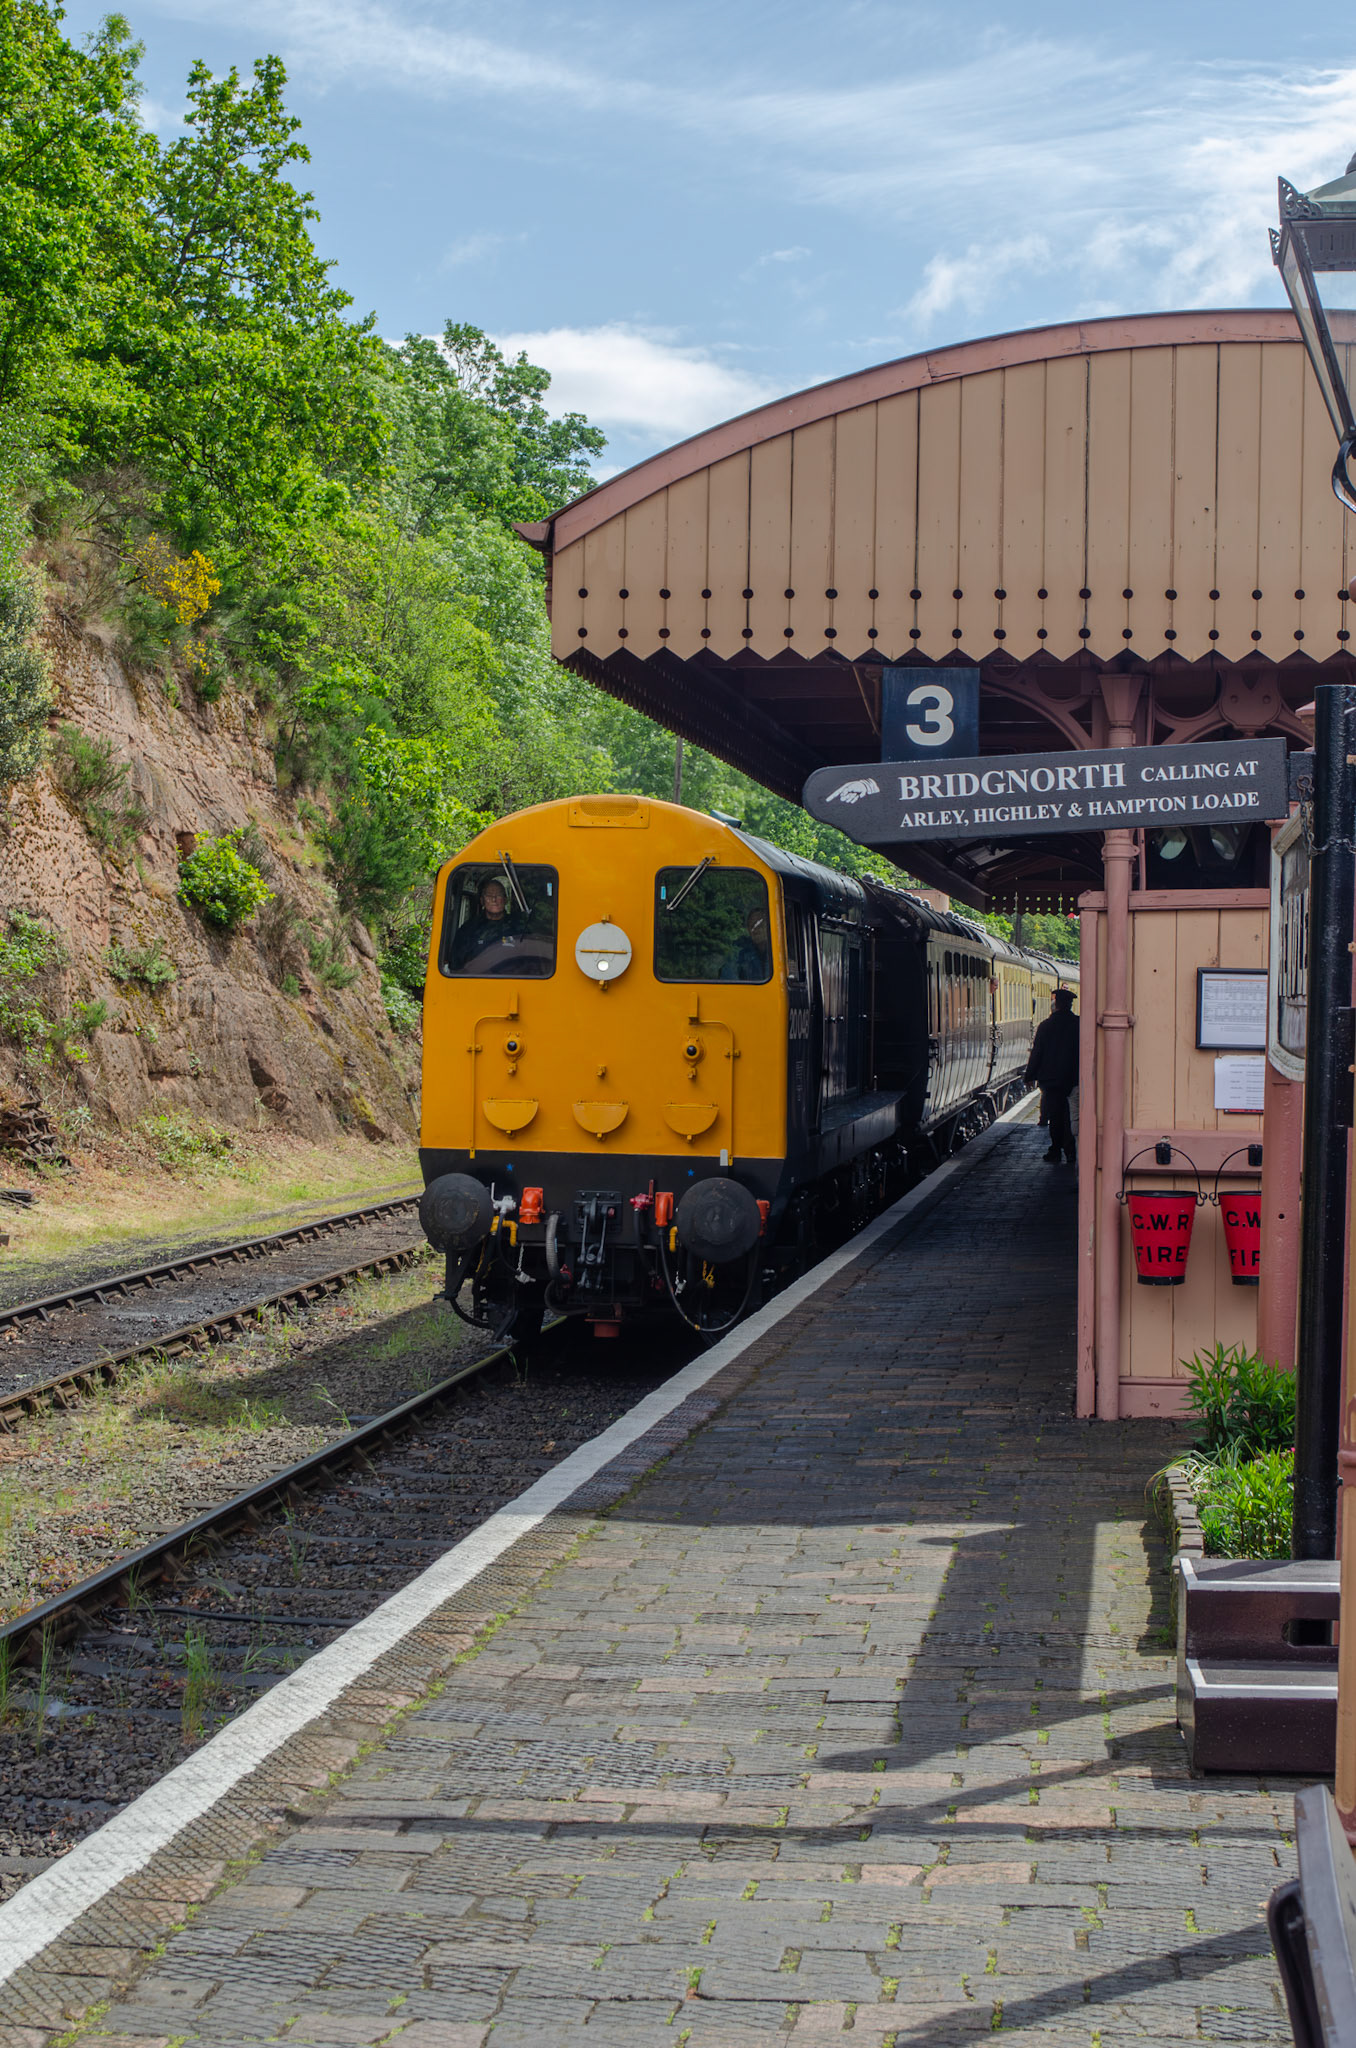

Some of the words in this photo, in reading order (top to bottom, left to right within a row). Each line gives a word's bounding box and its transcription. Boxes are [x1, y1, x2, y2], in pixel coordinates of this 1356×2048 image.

[905, 684, 955, 747] 3
[897, 762, 1127, 801] BRIDGNORTH
[1140, 762, 1230, 782] CALLING
[1233, 760, 1259, 777] AT
[900, 809, 969, 828] ARLEY,
[973, 803, 1064, 823] HIGHLEY
[1067, 802, 1083, 818] &
[1088, 795, 1187, 817] HAMPTON
[1191, 791, 1260, 810] LOADE
[1136, 1246, 1186, 1263] FIRE
